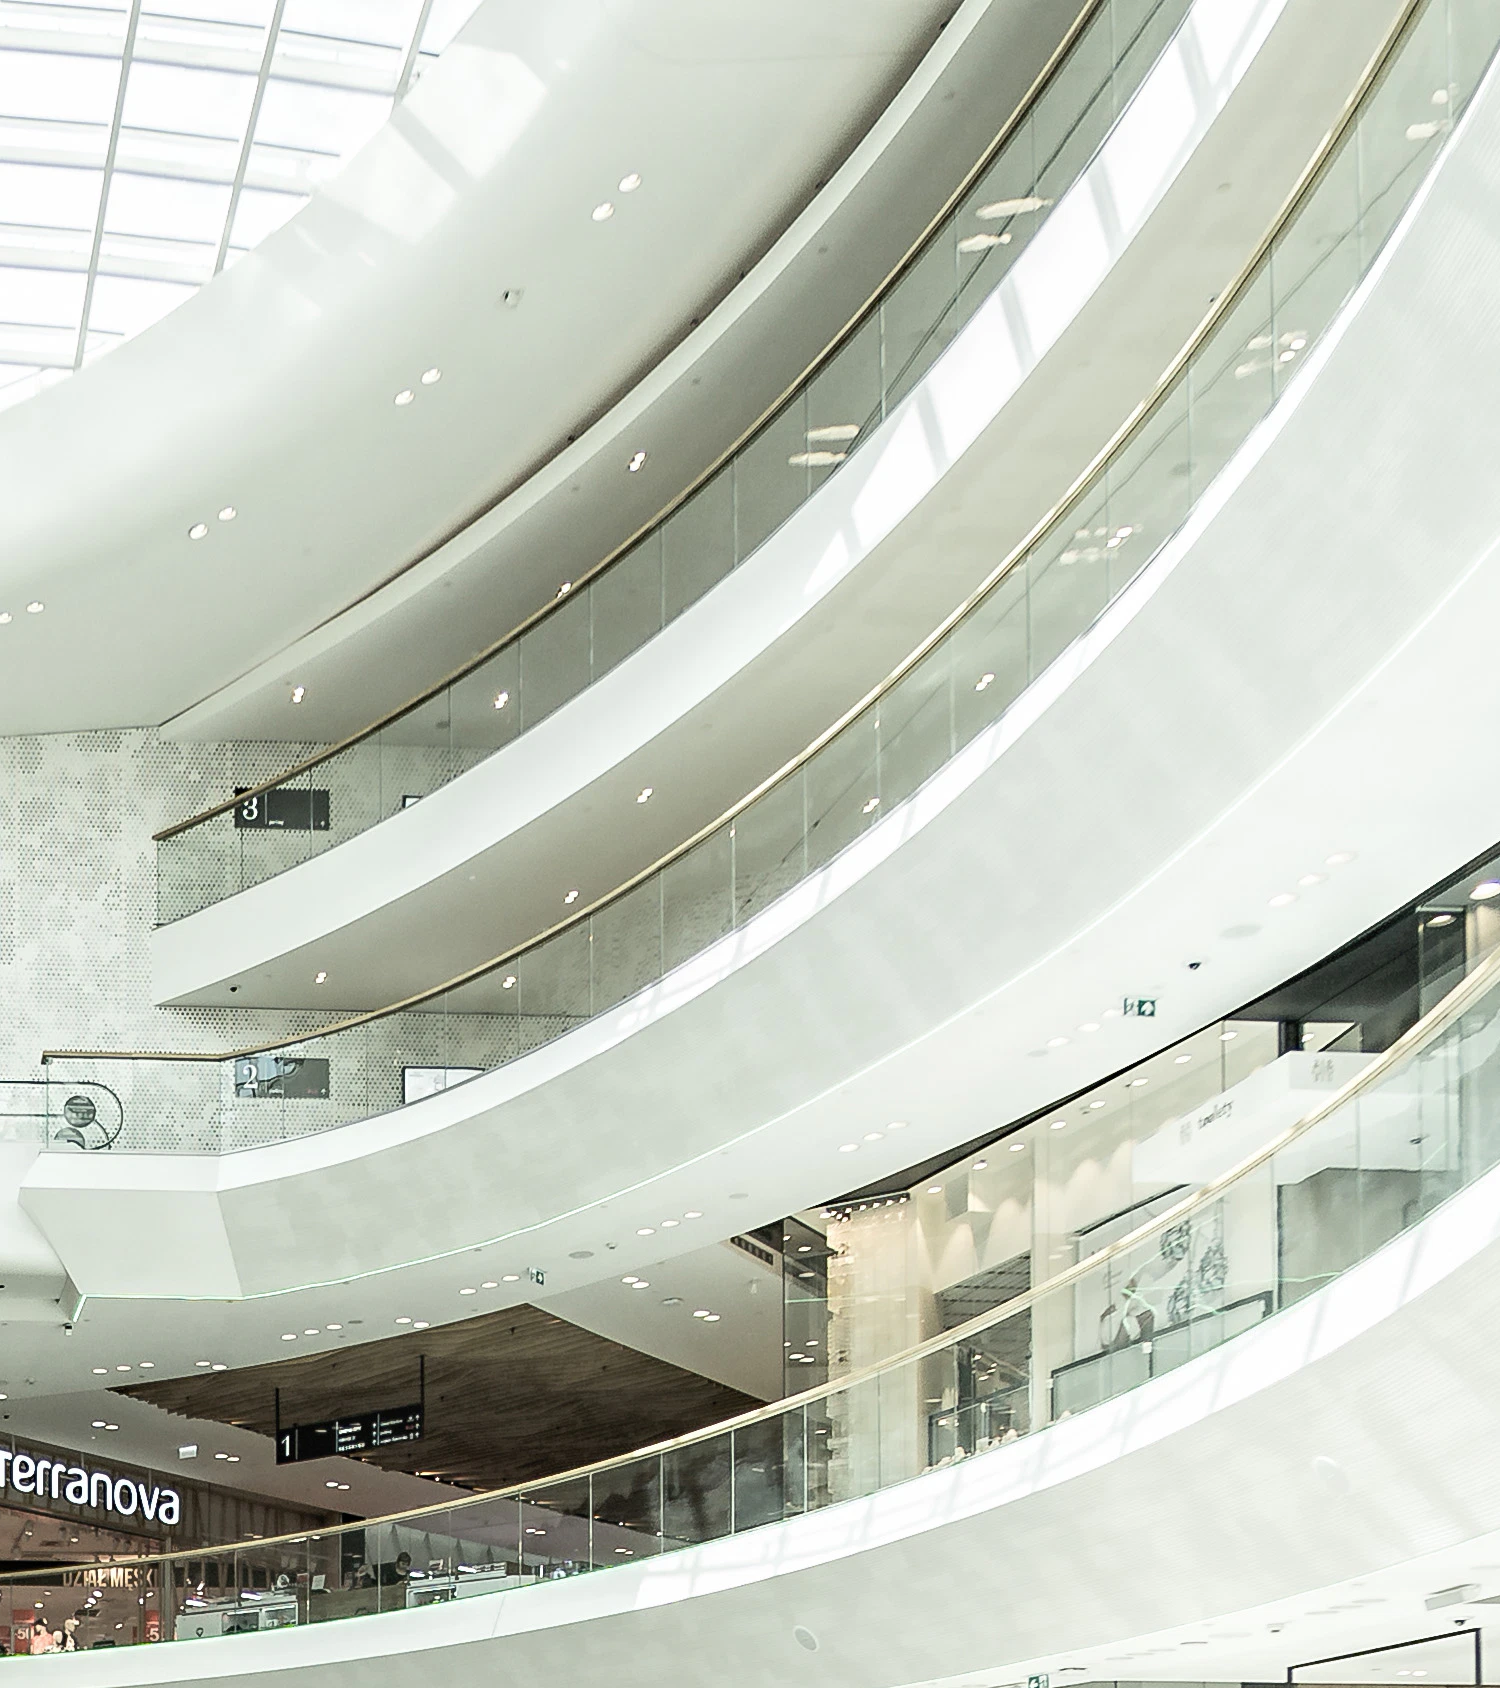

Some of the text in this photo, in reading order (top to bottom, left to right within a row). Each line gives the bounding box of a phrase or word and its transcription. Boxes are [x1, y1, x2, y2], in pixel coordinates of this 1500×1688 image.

[242, 797, 258, 820] 3
[243, 1065, 258, 1089] 2
[281, 1435, 290, 1457] 1
